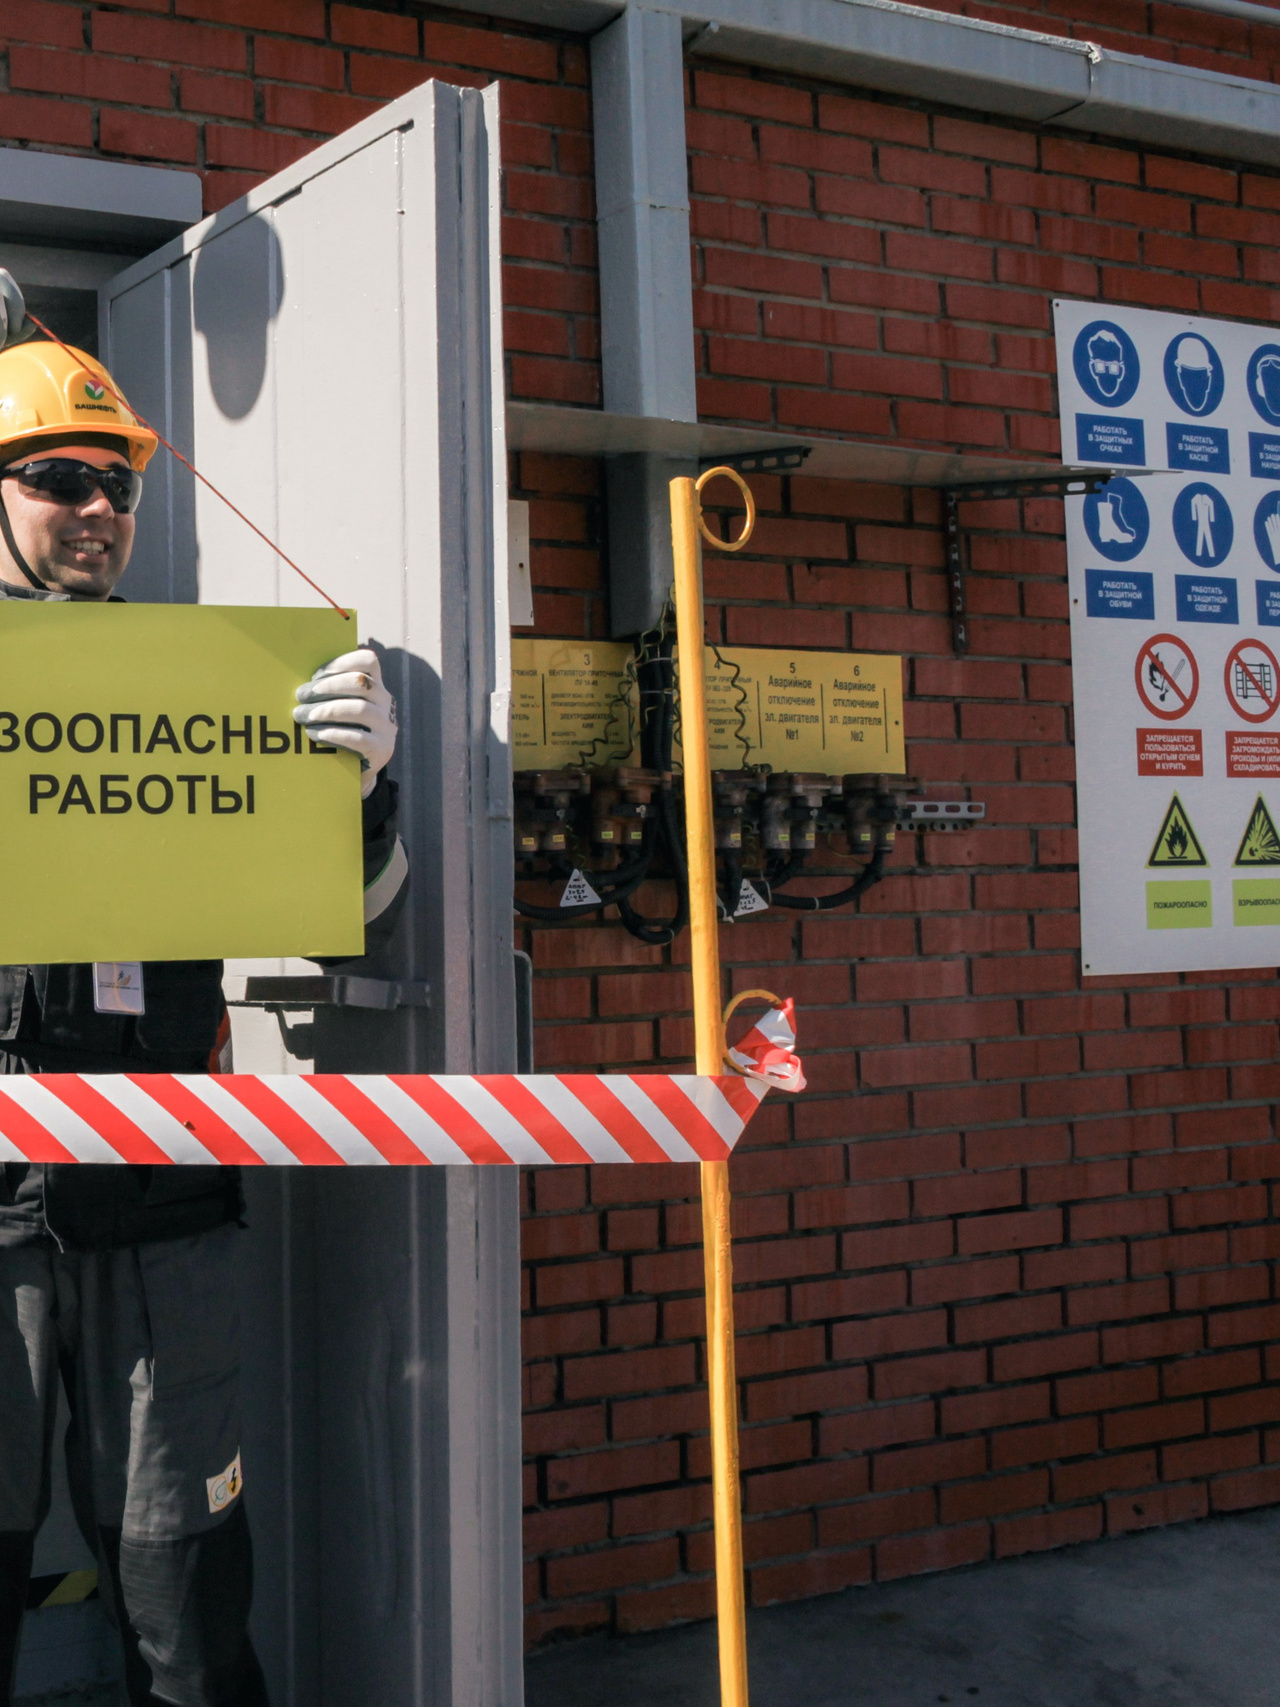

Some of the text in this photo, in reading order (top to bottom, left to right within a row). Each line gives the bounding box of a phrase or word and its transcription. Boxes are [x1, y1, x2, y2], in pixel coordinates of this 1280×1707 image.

[1093, 424, 1127, 435] РАБОТАТЬ
[1088, 434, 1133, 444] В ЗАЩИТНЫХ
[1182, 435, 1213, 444] РАБОТАТЬ
[1100, 444, 1122, 453] ОЧКАХ
[1184, 444, 1218, 454] ЗАЩИТНОЙ
[1189, 453, 1209, 462] КАСКЕ
[1102, 581, 1137, 590] РАБОТАТЬ
[1191, 585, 1222, 595] РАБОТАТЬ
[1104, 591, 1142, 600] ЗАЩИТНОЙ
[1193, 595, 1228, 604] ЗАЩИТНОЙ
[1109, 600, 1132, 608] ОБУВИ
[1195, 604, 1221, 613] ОДЕЖДЕ
[584, 654, 590, 666] 3
[714, 660, 721, 670] 4
[790, 662, 796, 673] 5
[854, 665, 860, 676] 6
[768, 675, 812, 691] Аварийное
[833, 679, 876, 693] Аварийное
[768, 696, 815, 706] отключение
[833, 699, 879, 709] отключение
[765, 712, 819, 723] эл. двигателя
[829, 715, 882, 726] эл. двигателя
[786, 729, 799, 740] №1
[851, 731, 864, 742] №2
[1146, 735, 1194, 743] ЗАПРЕЩАЕТСЯ
[1234, 737, 1278, 745] ЗАПРЕЩАЕТСЯ
[1145, 744, 1195, 752] ПОЛЬЗОВАТЬСЯ
[28, 774, 255, 815] РАБОТЫ
[1154, 901, 1207, 909] ПОЖАРООПАСНО
